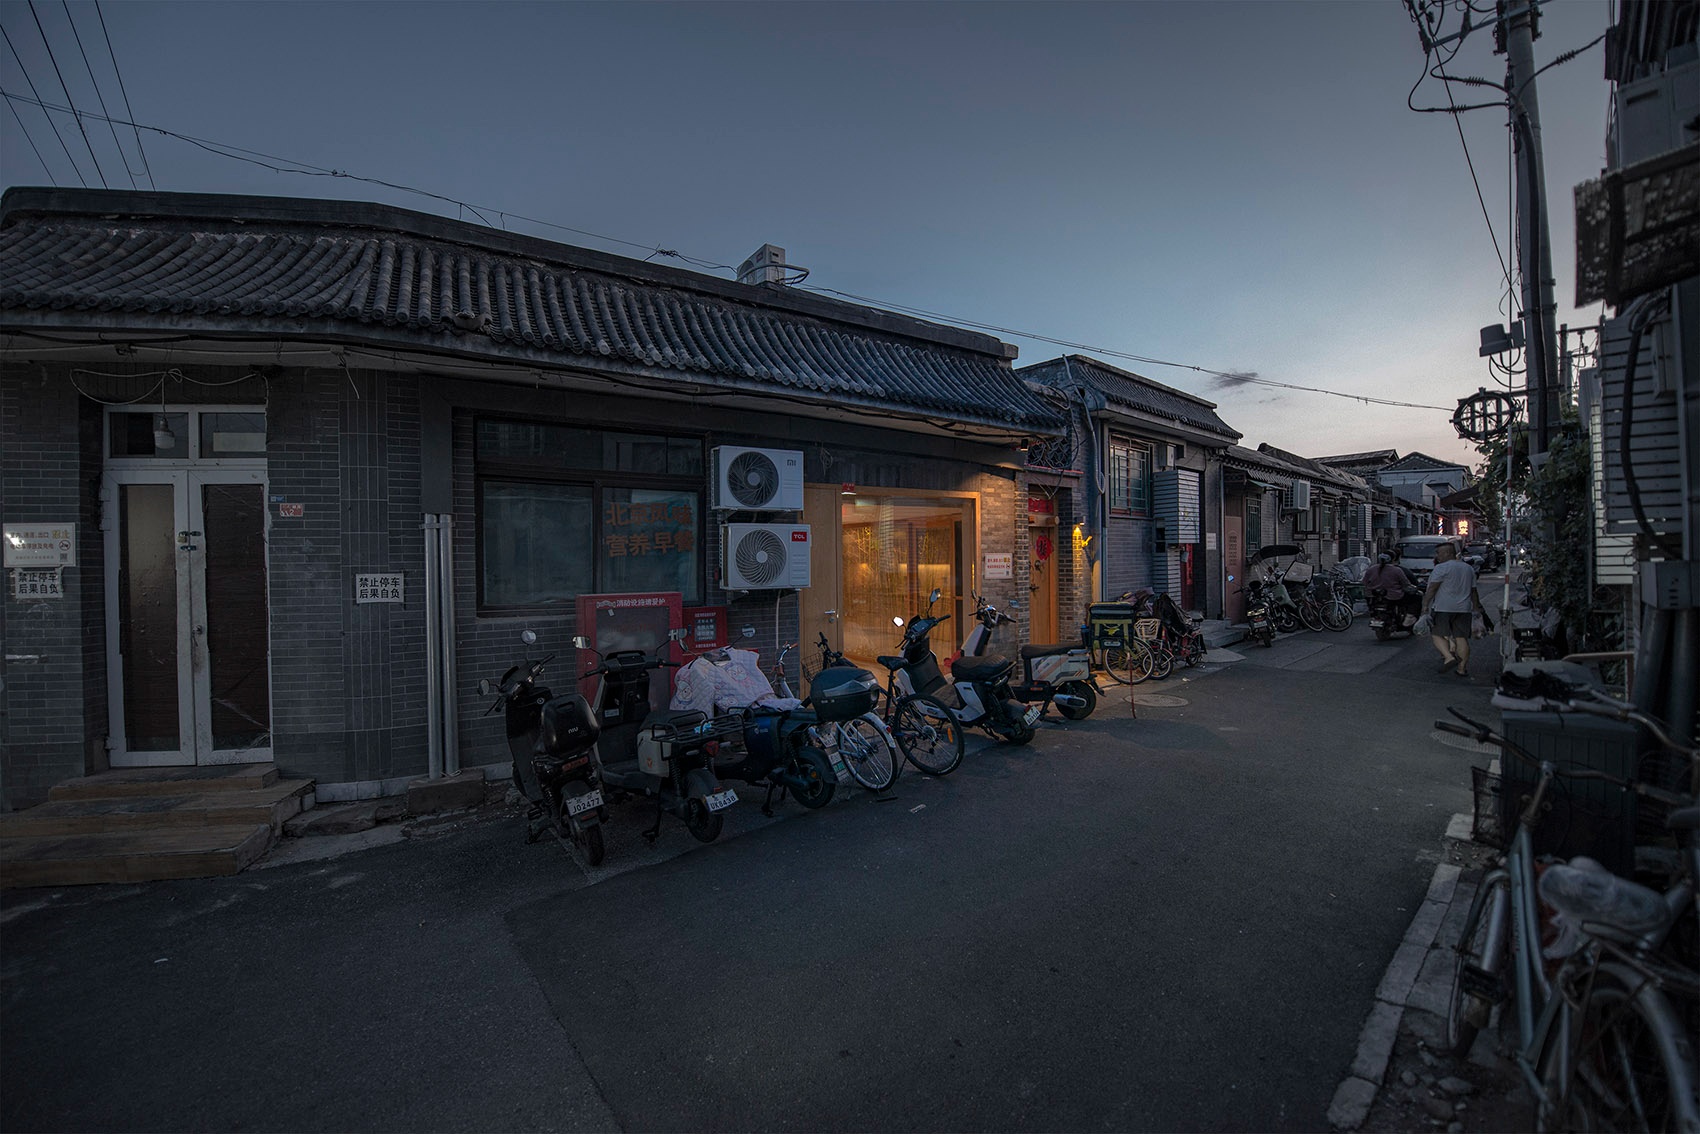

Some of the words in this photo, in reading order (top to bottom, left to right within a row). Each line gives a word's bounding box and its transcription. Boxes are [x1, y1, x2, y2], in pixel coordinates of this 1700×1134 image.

[605, 502, 692, 527] 北京风味
[605, 530, 695, 558] 营养早餐
[18, 572, 58, 583] 禁止停车
[359, 577, 400, 588] 禁止停车
[18, 584, 59, 594] 后果自负
[359, 589, 400, 599] 后果自负
[572, 797, 600, 814] J02477
